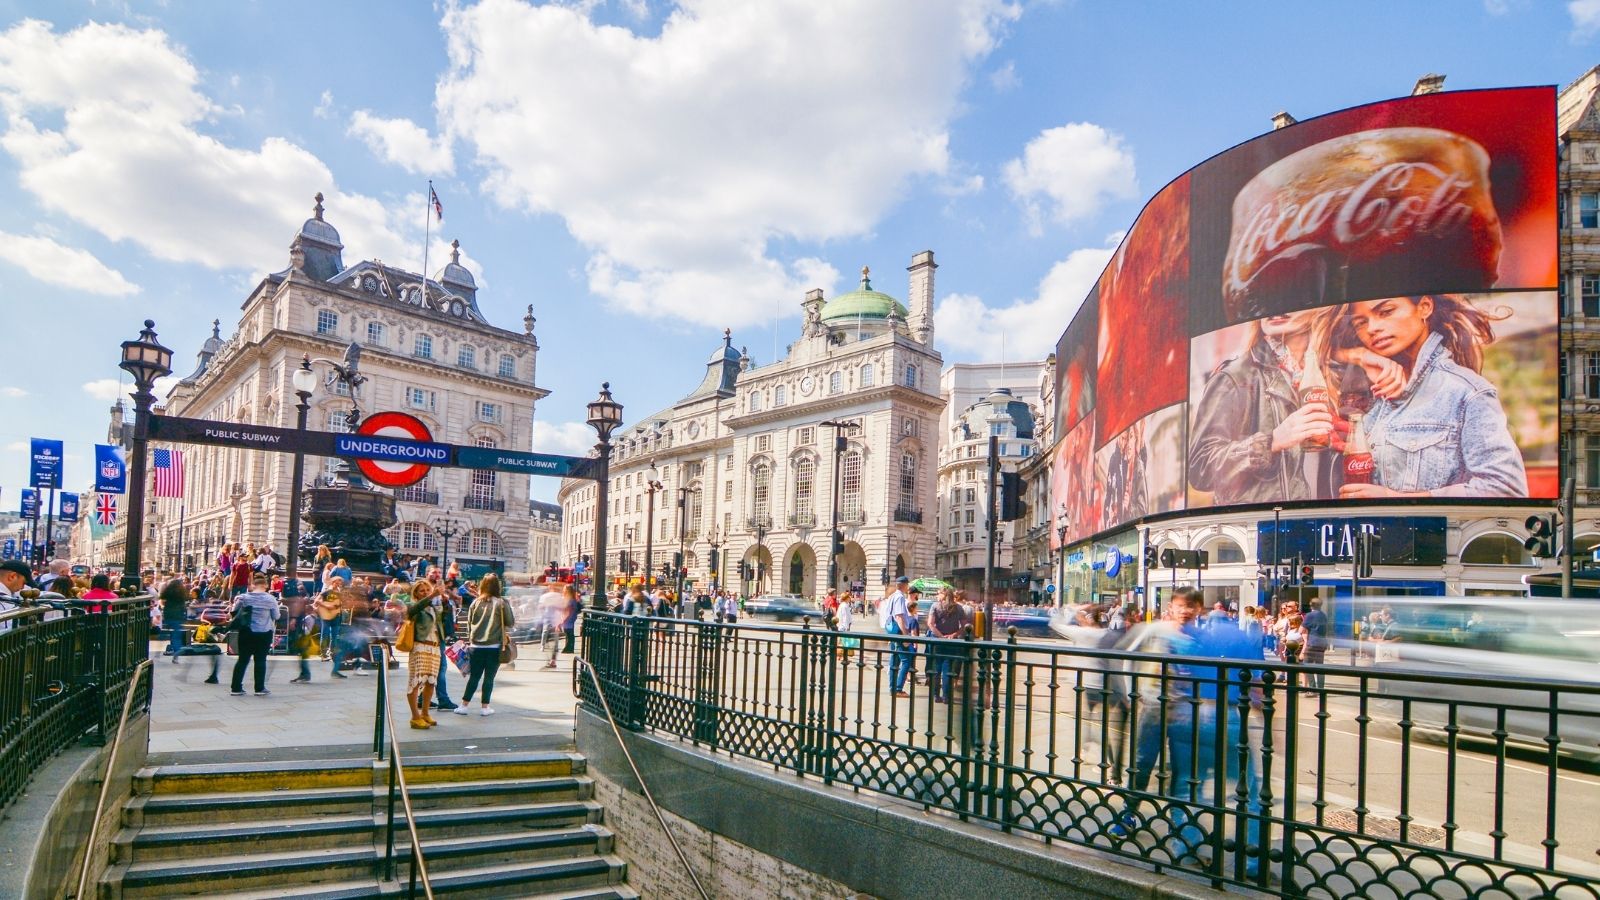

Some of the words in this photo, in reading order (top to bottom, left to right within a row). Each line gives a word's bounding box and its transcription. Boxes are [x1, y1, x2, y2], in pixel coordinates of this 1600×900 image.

[205, 429, 239, 440] PUBLIC
[241, 432, 281, 443] SUBWAY
[341, 440, 447, 459] UNDERGROUND
[497, 457, 525, 466] PUBLIC
[526, 459, 558, 469] SUBWAY
[104, 468, 119, 477] NFL
